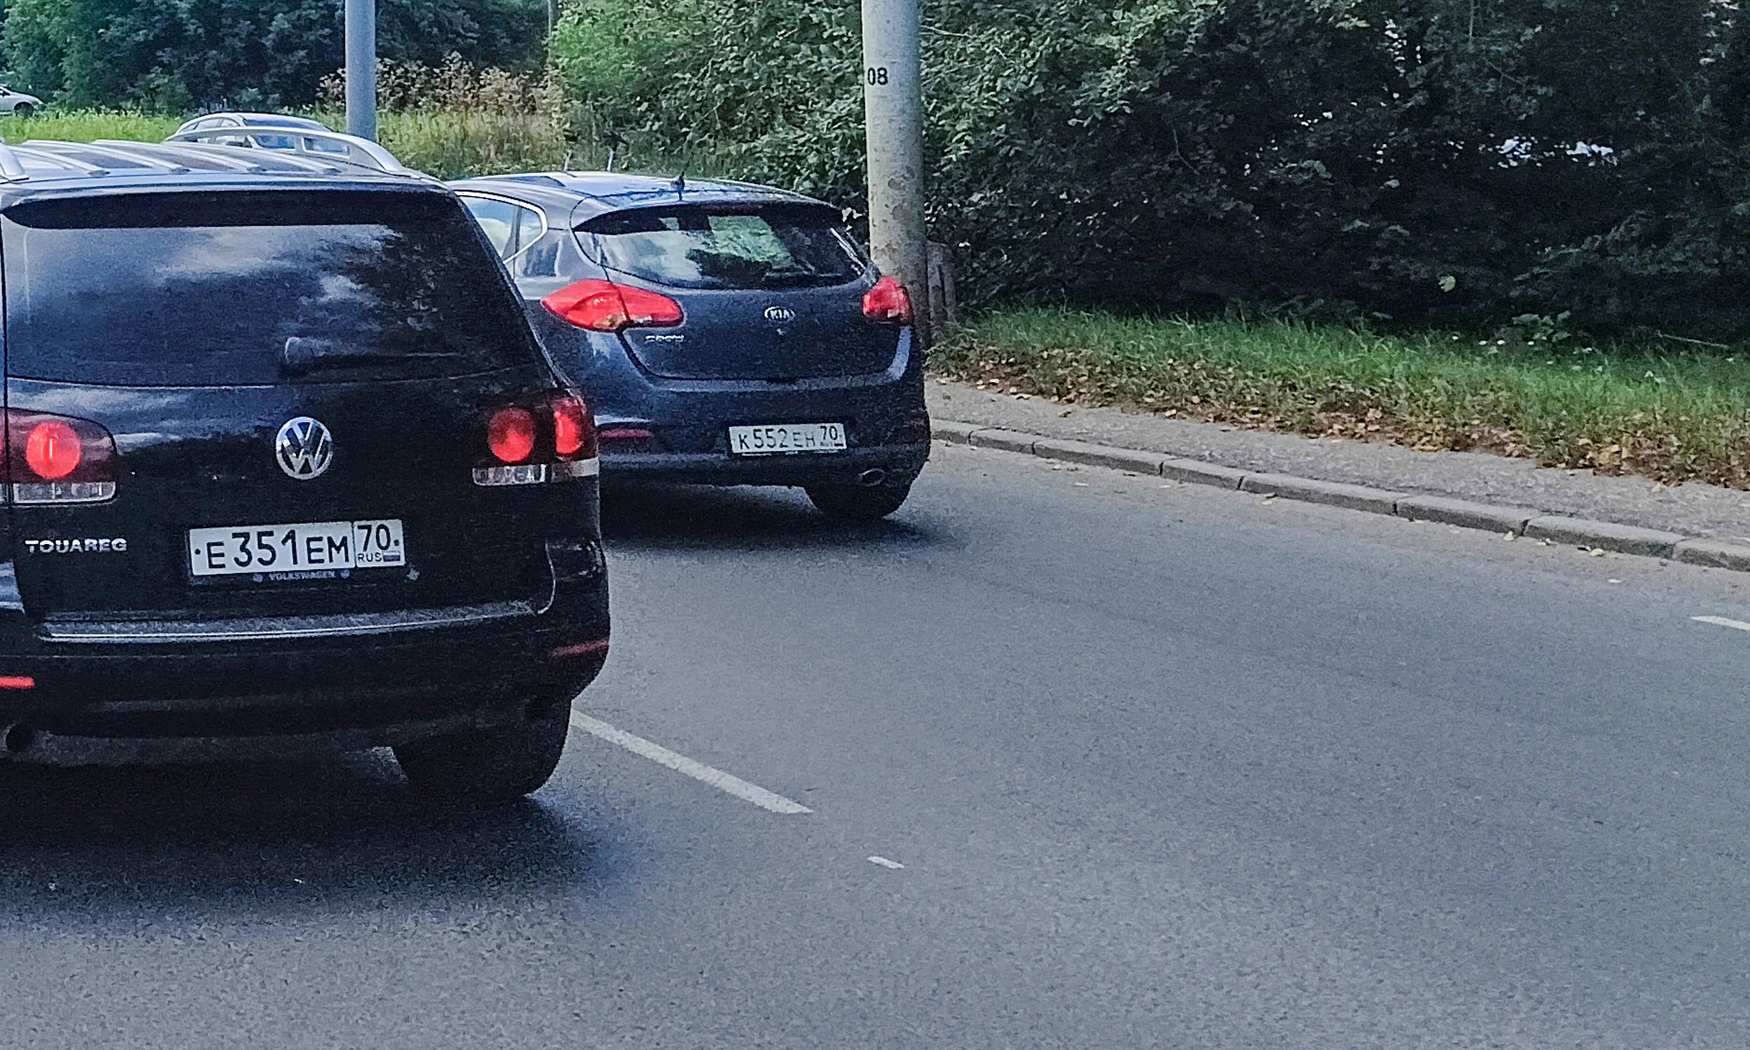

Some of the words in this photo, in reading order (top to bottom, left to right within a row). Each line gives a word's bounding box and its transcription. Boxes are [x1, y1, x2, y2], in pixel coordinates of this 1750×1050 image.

[867, 67, 888, 86] 08
[770, 309, 790, 320] KIA
[25, 537, 128, 554] TOUAREG
[357, 552, 382, 563] RUS
[268, 570, 337, 581] VOLKSWAGEN
